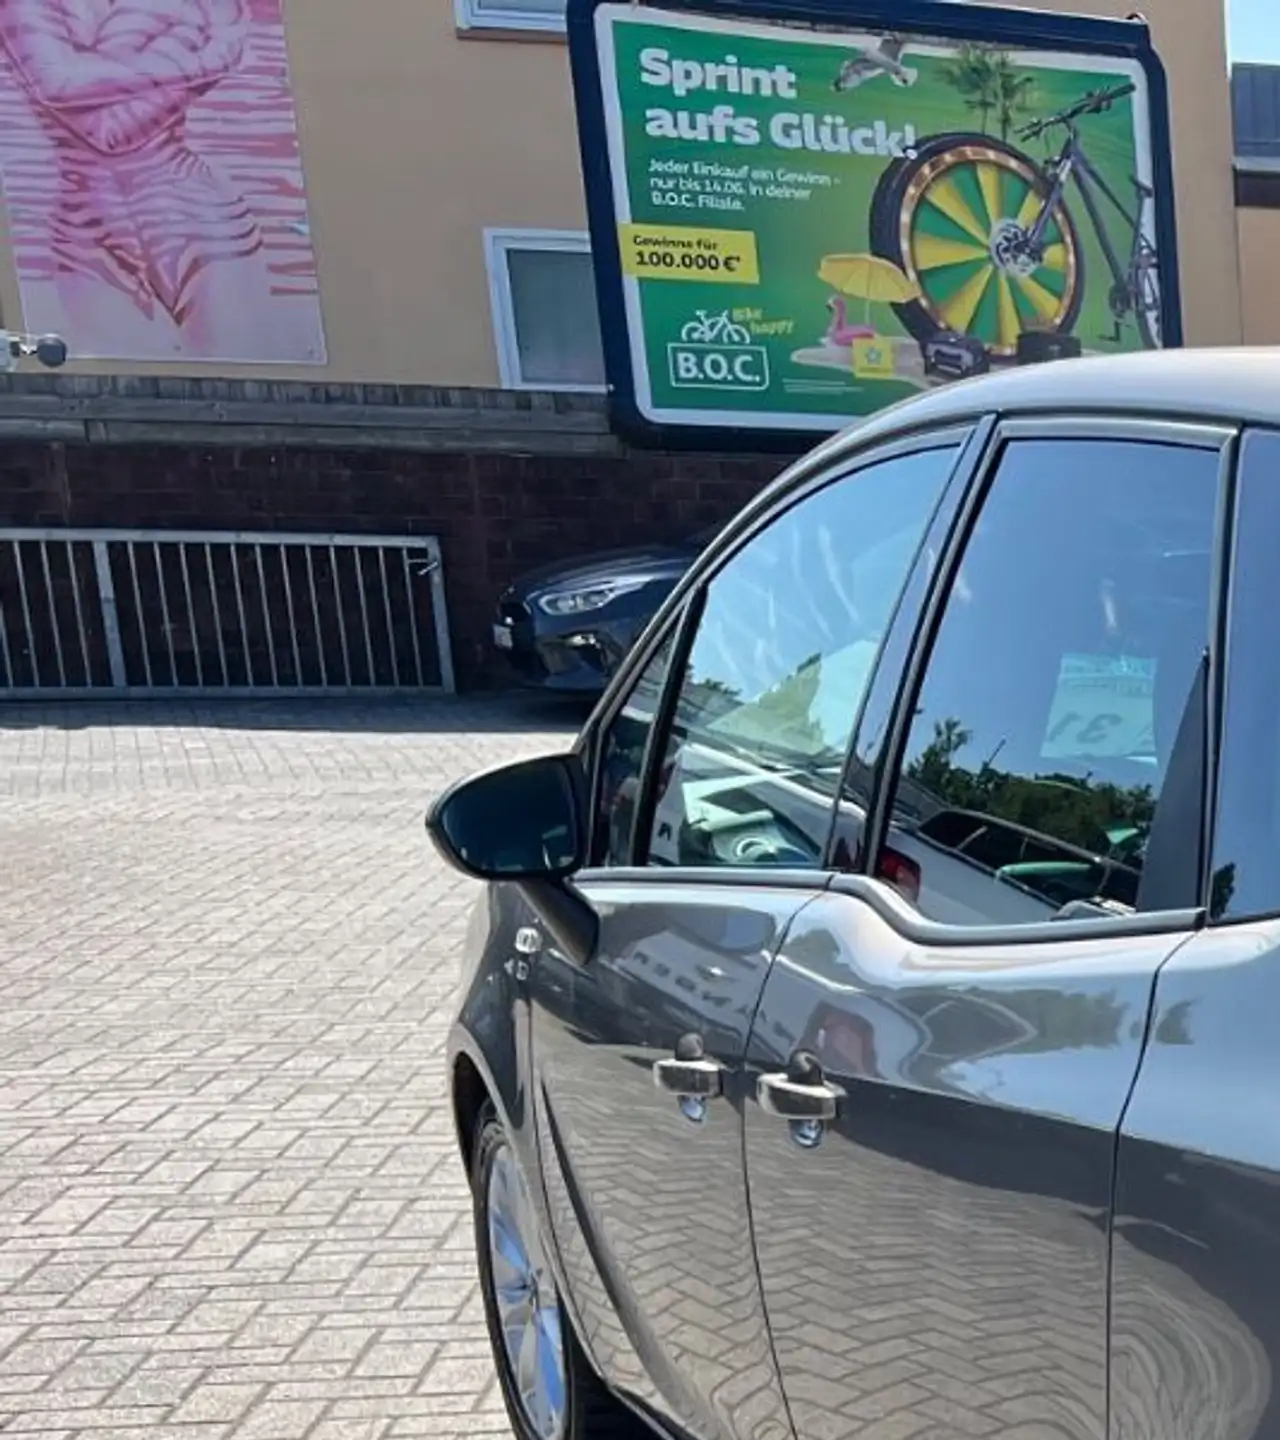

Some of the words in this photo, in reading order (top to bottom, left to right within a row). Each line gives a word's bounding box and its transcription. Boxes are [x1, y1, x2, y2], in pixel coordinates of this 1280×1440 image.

[640, 48, 797, 98] Sprint
[645, 105, 760, 145] aufs
[769, 112, 918, 160] Glück!
[649, 159, 689, 173] Jeder
[693, 161, 750, 178] Einkauf
[776, 168, 832, 186] Gewinn
[650, 177, 677, 189] nur
[679, 178, 700, 192] bis
[750, 183, 763, 196] in
[633, 235, 694, 250] Gewinne
[696, 238, 718, 251] für
[635, 251, 720, 271] 100.000
[676, 352, 760, 383] B.O.C.
